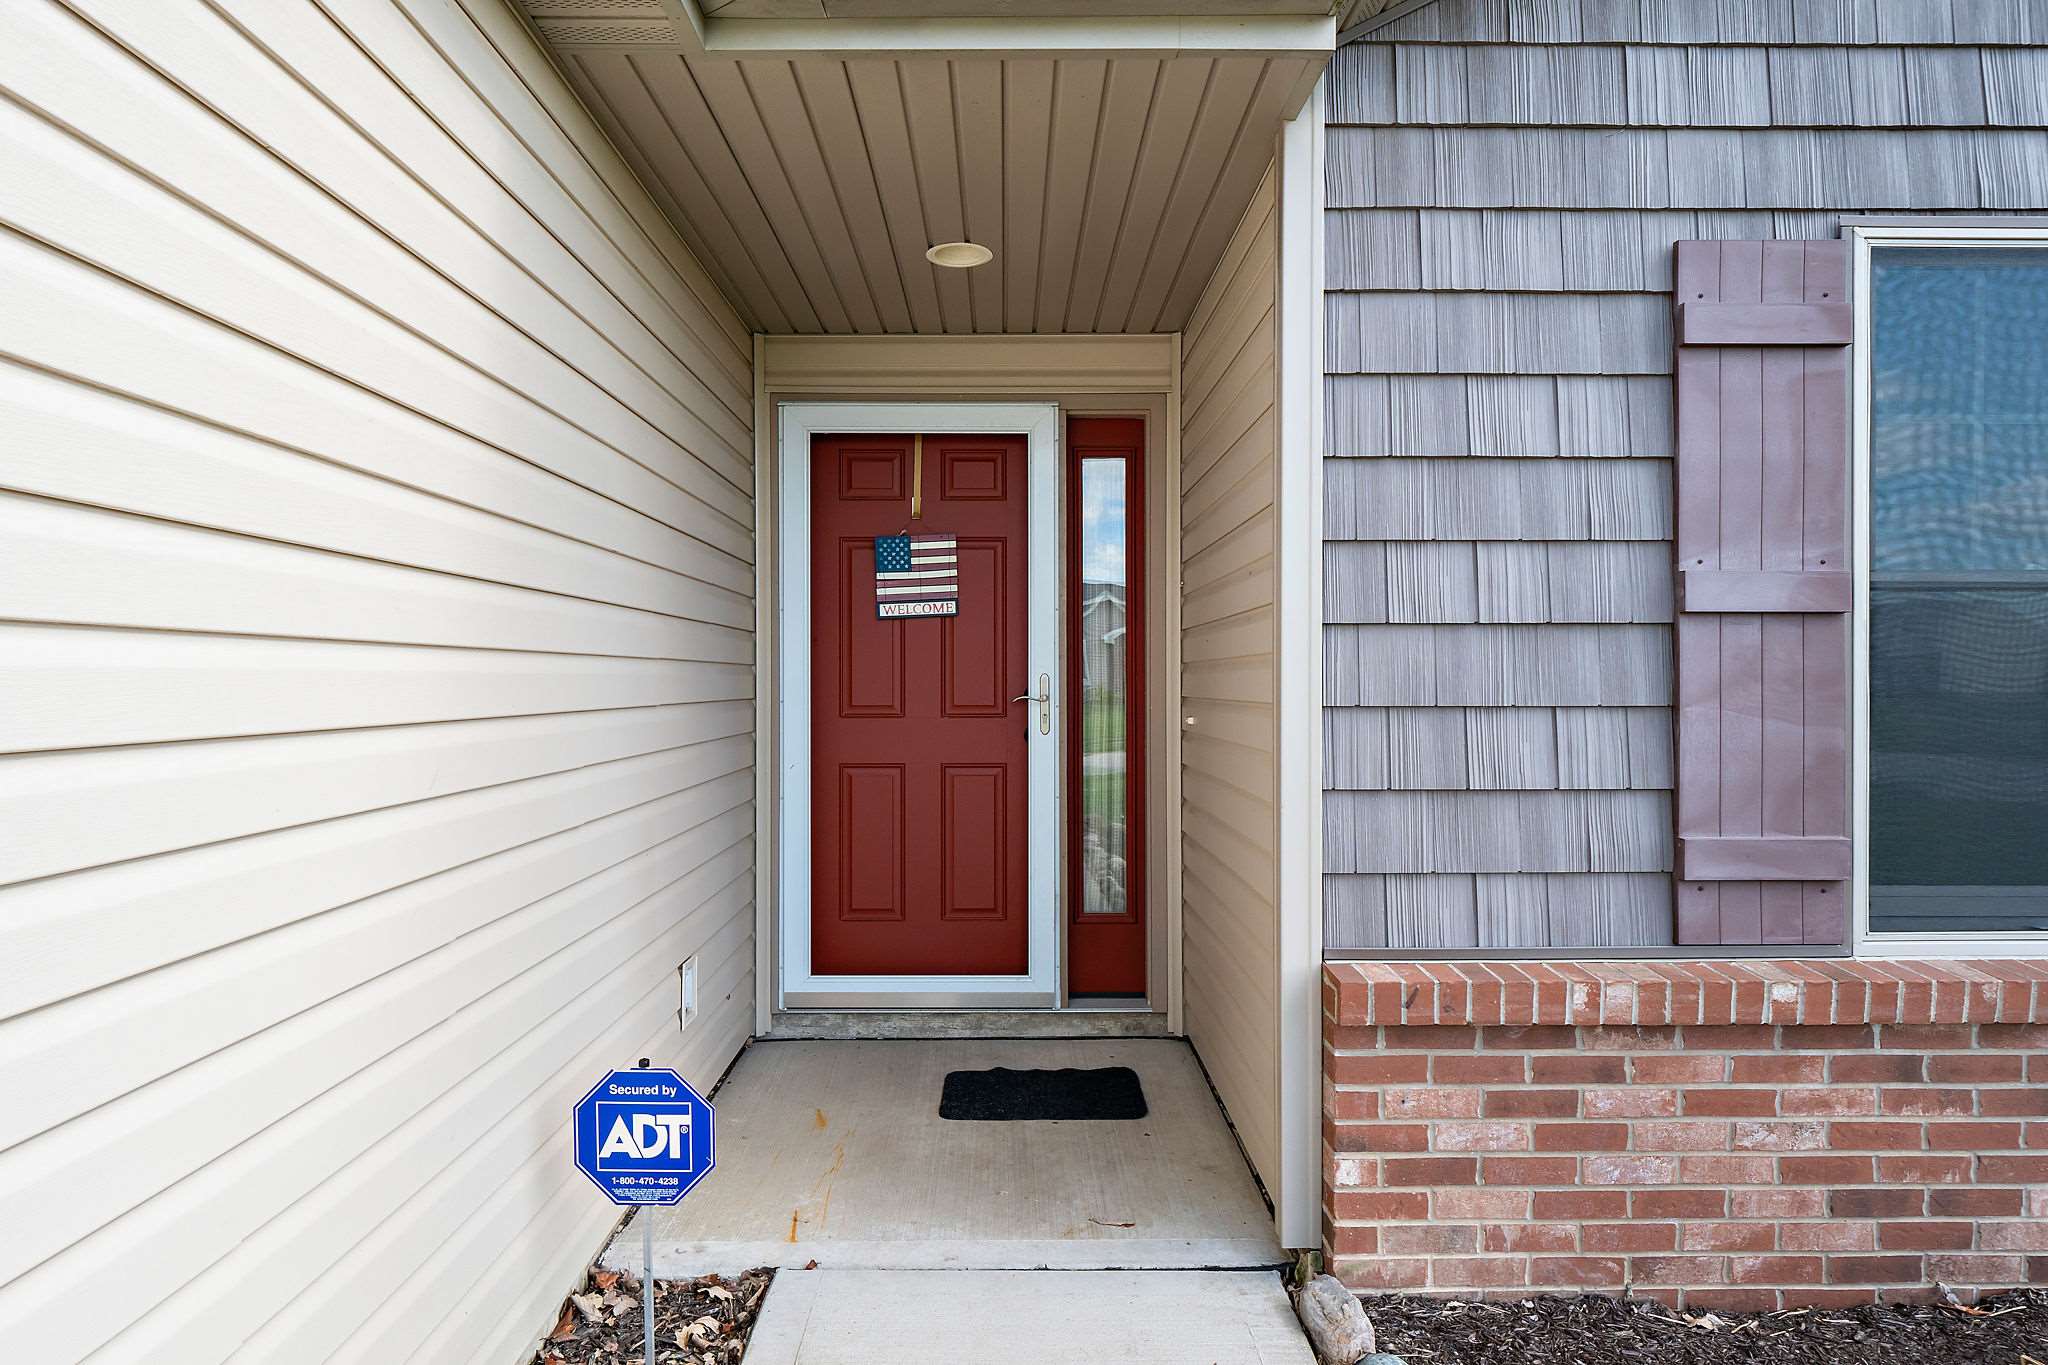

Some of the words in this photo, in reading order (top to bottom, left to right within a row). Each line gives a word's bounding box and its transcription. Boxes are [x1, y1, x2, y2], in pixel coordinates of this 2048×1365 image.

[882, 602, 954, 615] WELCOME
[609, 1084, 659, 1096] Secured
[662, 1084, 677, 1098] by
[599, 1114, 691, 1159] ADT
[612, 1176, 679, 1186] 1-800-470-4238
